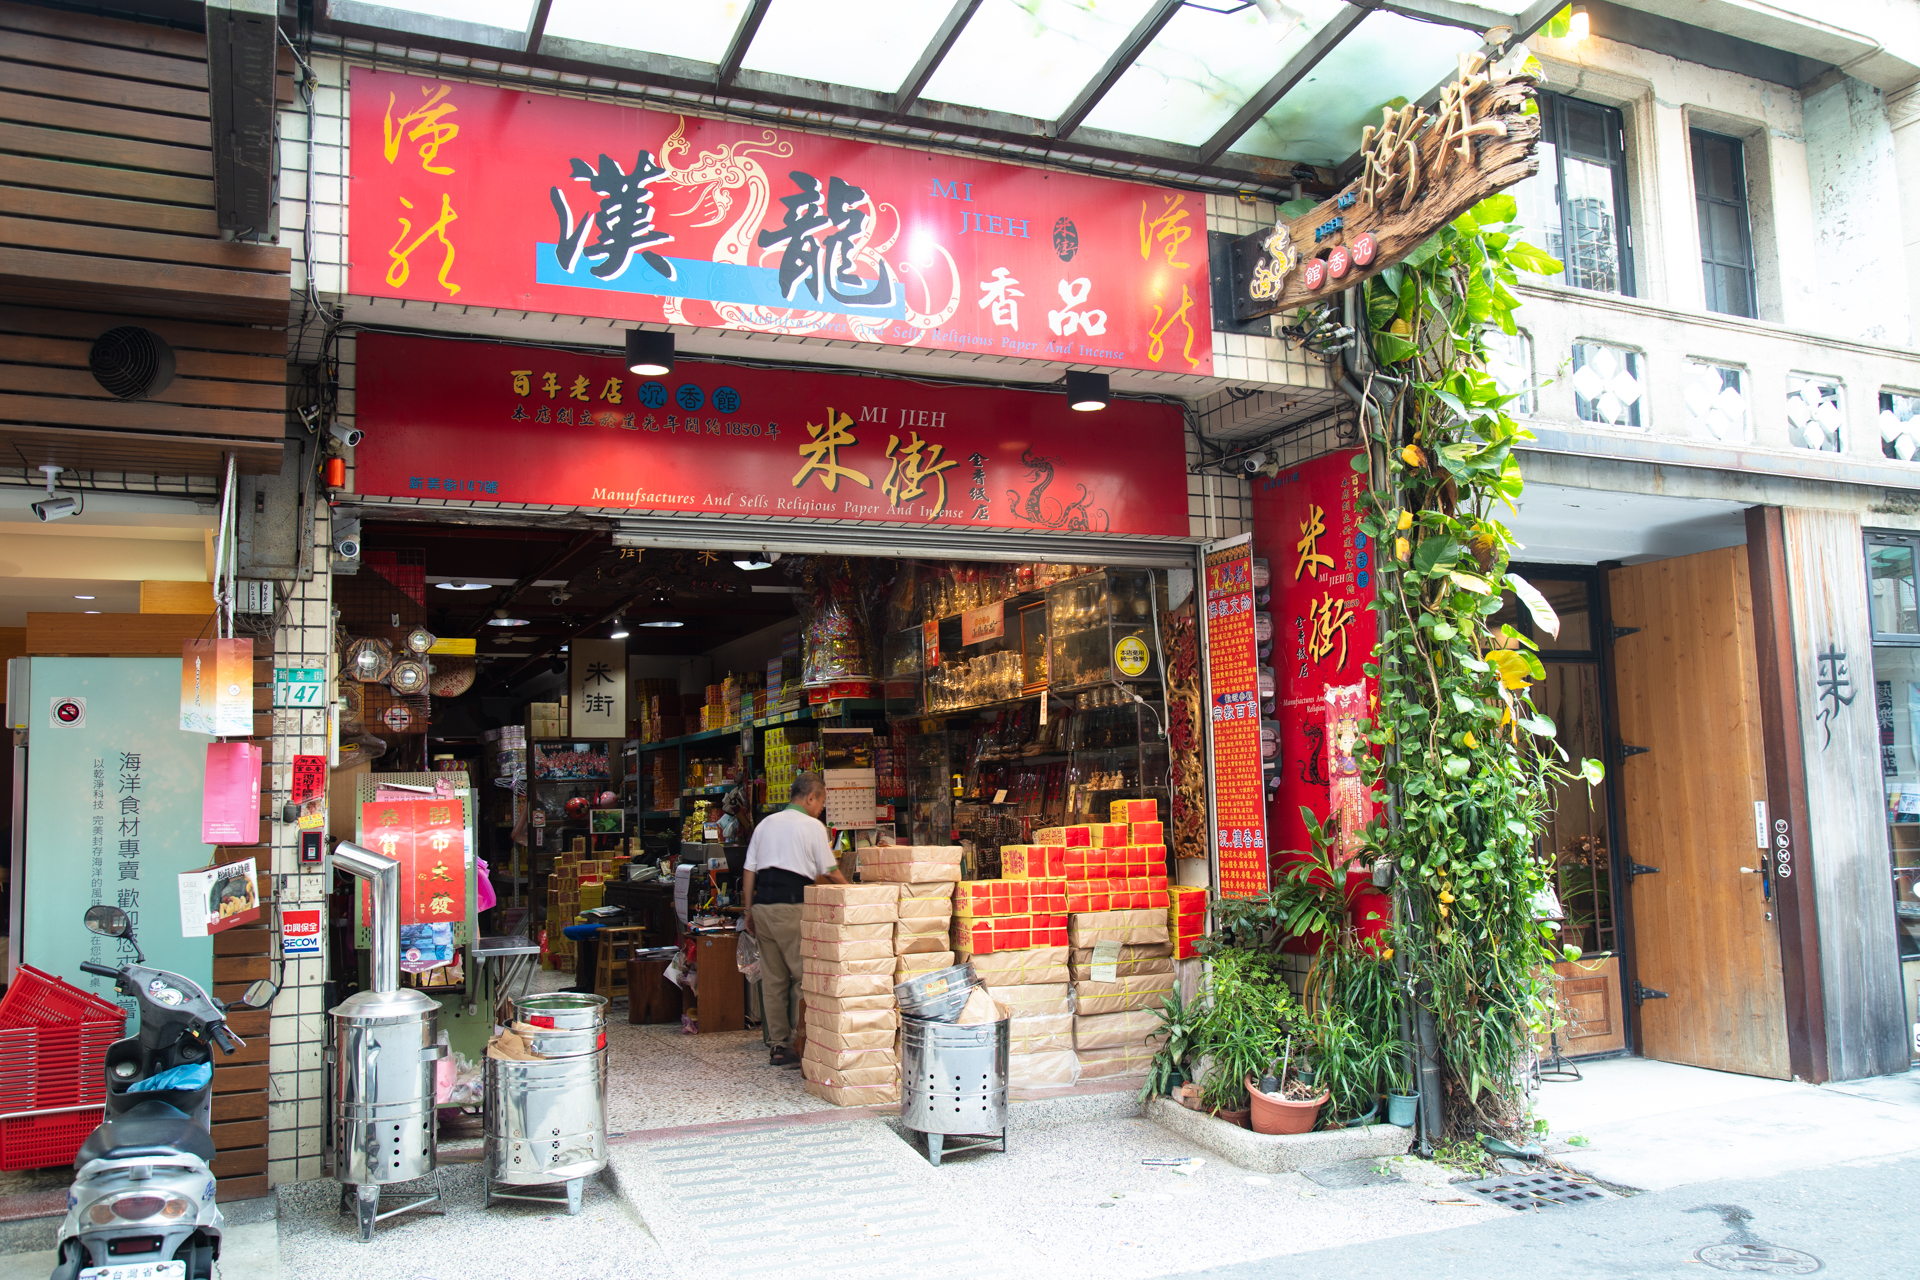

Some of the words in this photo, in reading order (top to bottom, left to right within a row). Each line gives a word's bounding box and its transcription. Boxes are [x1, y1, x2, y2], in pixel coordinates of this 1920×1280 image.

[930, 178, 974, 203] MI
[550, 149, 899, 308] 漢龍
[958, 210, 1031, 239] JIEH
[979, 266, 1107, 338] 香品
[855, 322, 884, 337] And
[893, 325, 924, 341] Sells
[932, 328, 994, 349] Religious
[1001, 336, 1038, 355] Paper
[1045, 341, 1074, 355] And
[1079, 344, 1125, 361] Incense
[510, 369, 624, 405] 百年老店
[639, 383, 740, 413] 沉香館
[859, 406, 888, 423] MI
[898, 408, 947, 428] JIEH
[792, 407, 959, 520] 米街
[410, 476, 499, 494] 新美街147號
[968, 451, 991, 521] 金香紙店
[591, 488, 696, 507] Manufsactures
[703, 493, 735, 507] And
[739, 494, 769, 508] Sells
[776, 497, 837, 516] Religious
[844, 501, 880, 518] Paper
[886, 503, 915, 516] And
[1319, 572, 1329, 583] MI
[1329, 574, 1345, 588] JIEH
[278, 670, 323, 681] 新美街
[584, 661, 616, 718] 米街
[282, 685, 319, 703] 147
[1213, 701, 1257, 722] 宗教百貨
[93, 757, 105, 811] 以乾淨科技
[429, 806, 455, 916] 開市大發
[283, 922, 318, 933] 中興保全
[283, 937, 318, 949] SECOM
